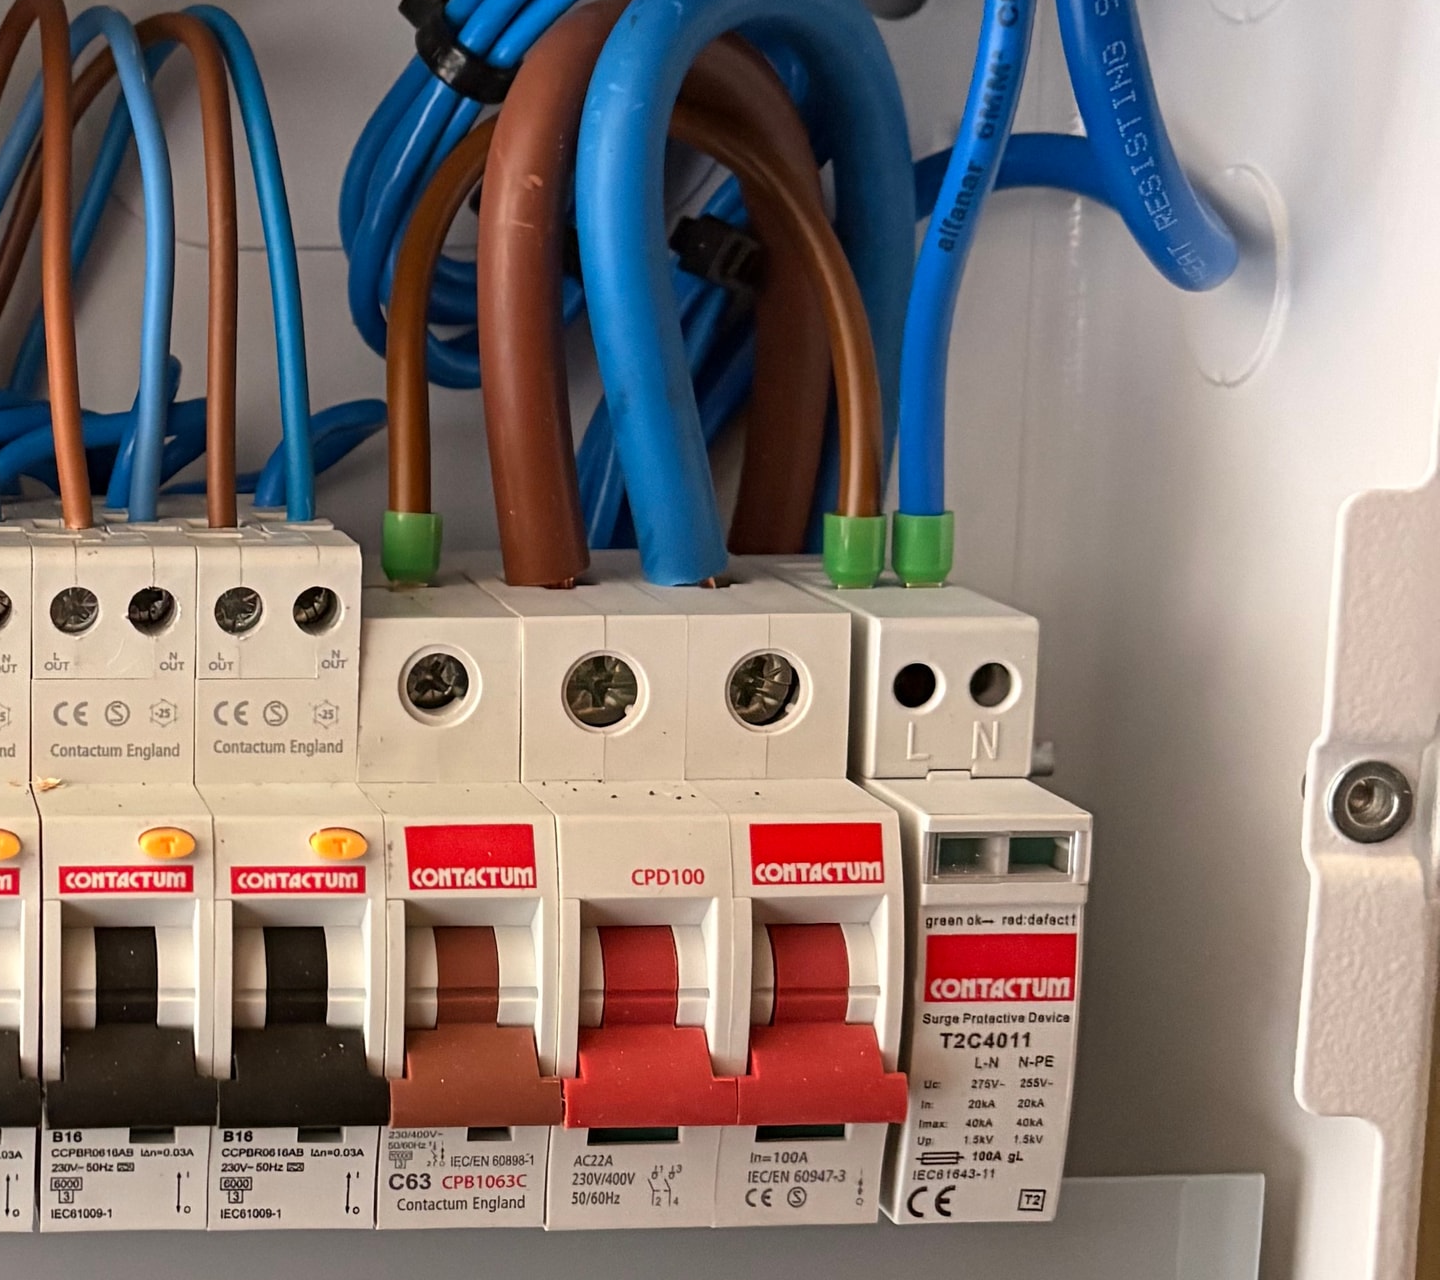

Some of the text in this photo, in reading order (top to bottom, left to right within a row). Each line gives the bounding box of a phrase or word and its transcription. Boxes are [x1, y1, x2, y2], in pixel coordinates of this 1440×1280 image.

[1101, 38, 1180, 233] RESISTING
[936, 157, 986, 254] alfanar
[906, 719, 1001, 762] L N
[410, 866, 535, 888] CONTACTUM
[631, 868, 706, 887] CPD100
[754, 861, 883, 883] CONTACTUM
[925, 915, 963, 929] green
[929, 976, 1071, 1000] CONTACTUM
[922, 1011, 1071, 1026] Surge Protective Device
[939, 1032, 1031, 1049] T2C4011
[974, 1055, 1055, 1069] L-N N-PE
[968, 1099, 996, 1109] 20kA
[1017, 1098, 1045, 1109] 20kA
[965, 1118, 993, 1128] 40kA
[1016, 1118, 1044, 1128] 40kA
[964, 1134, 994, 1145] 1.5kV
[1014, 1134, 1044, 1145] 1.5kV
[450, 1155, 535, 1168] IEC/EN 60898-1
[573, 1154, 613, 1168] AC22A
[750, 1151, 809, 1164] In=100A
[971, 1150, 1024, 1164] 100A gL
[388, 1172, 528, 1191] C63 CPB1063C
[571, 1172, 636, 1186] 230V/400V
[747, 1169, 846, 1183] IEC/EN 60947-3
[912, 1169, 996, 1181] IEC61643-11
[396, 1195, 526, 1213] Contactum England
[571, 1191, 620, 1205] 50/60Hz
